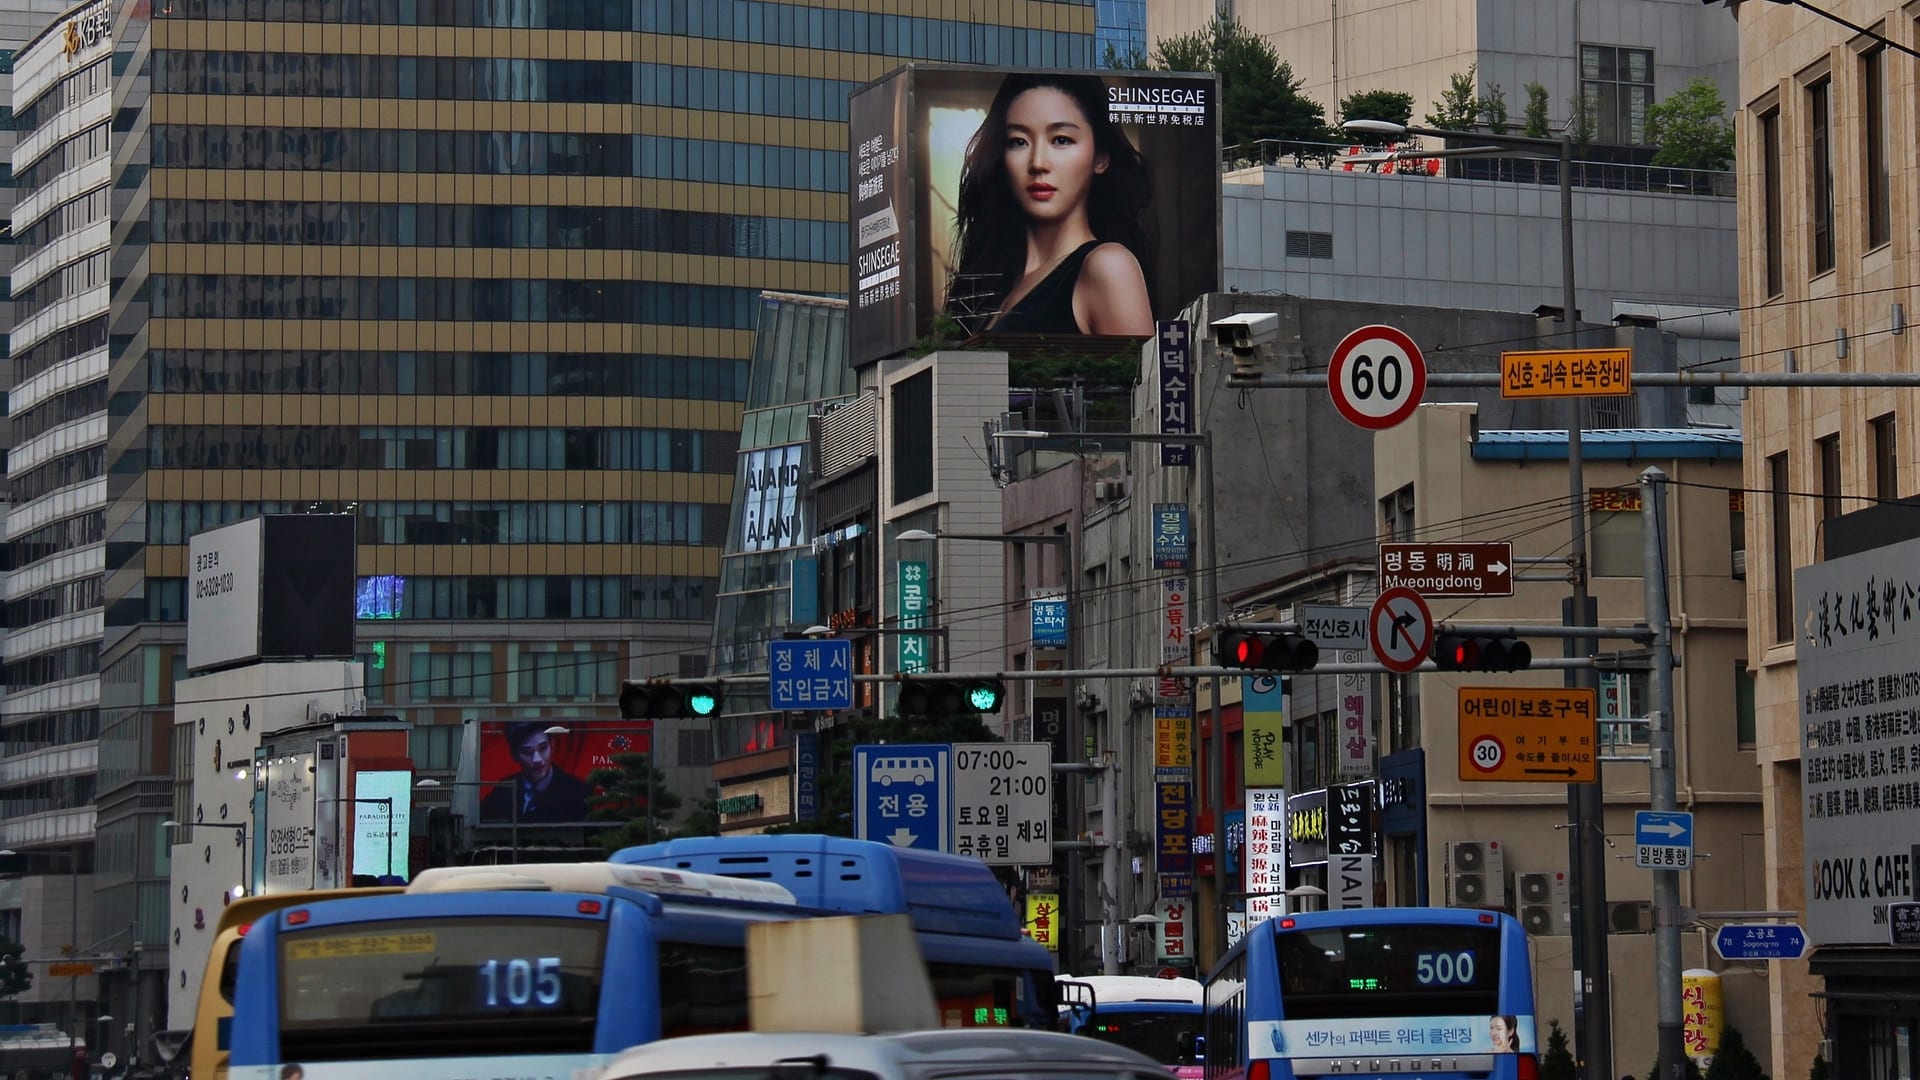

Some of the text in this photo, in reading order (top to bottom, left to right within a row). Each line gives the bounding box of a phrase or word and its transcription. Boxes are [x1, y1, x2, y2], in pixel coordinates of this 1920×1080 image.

[1108, 87, 1205, 104] SHINSEGAE
[1109, 112, 1205, 126] 韩际新世界免税店
[859, 241, 900, 277] SHINSEGAE
[1351, 355, 1402, 400] 60
[1571, 357, 1625, 389] 단속장비
[1170, 454, 1183, 463] 2F
[1156, 534, 1185, 546] 수선
[197, 551, 219, 572] 광고문의
[1385, 552, 1427, 571] 명동
[1385, 575, 1482, 590] Myeongdong
[1818, 574, 1920, 648] 漢文化藝術公
[1306, 618, 1367, 640] 적신호시
[777, 677, 848, 701] 진입금지
[1464, 698, 1591, 718] 어린이보호구역
[957, 750, 1028, 770] 07:00~
[1477, 744, 1499, 762] 30
[990, 776, 1047, 796] 21:00
[878, 794, 928, 818] 전용
[957, 804, 1010, 827] 토요일
[1162, 784, 1188, 855] 전당포
[1017, 819, 1047, 843] 제외
[1271, 820, 1281, 853] 마라탕
[957, 834, 1010, 858] 공휴일
[1640, 846, 1687, 866] 일방통행
[1812, 854, 1910, 900] BOOK & CAFE
[1746, 928, 1776, 939] 소공로
[1789, 937, 1800, 945] 74
[1743, 940, 1779, 949] Sogong-ro
[1417, 952, 1475, 984] 500
[480, 957, 562, 1005] 105
[1305, 1027, 1473, 1047] 센카의 퍼펙트 워터 클렌징
